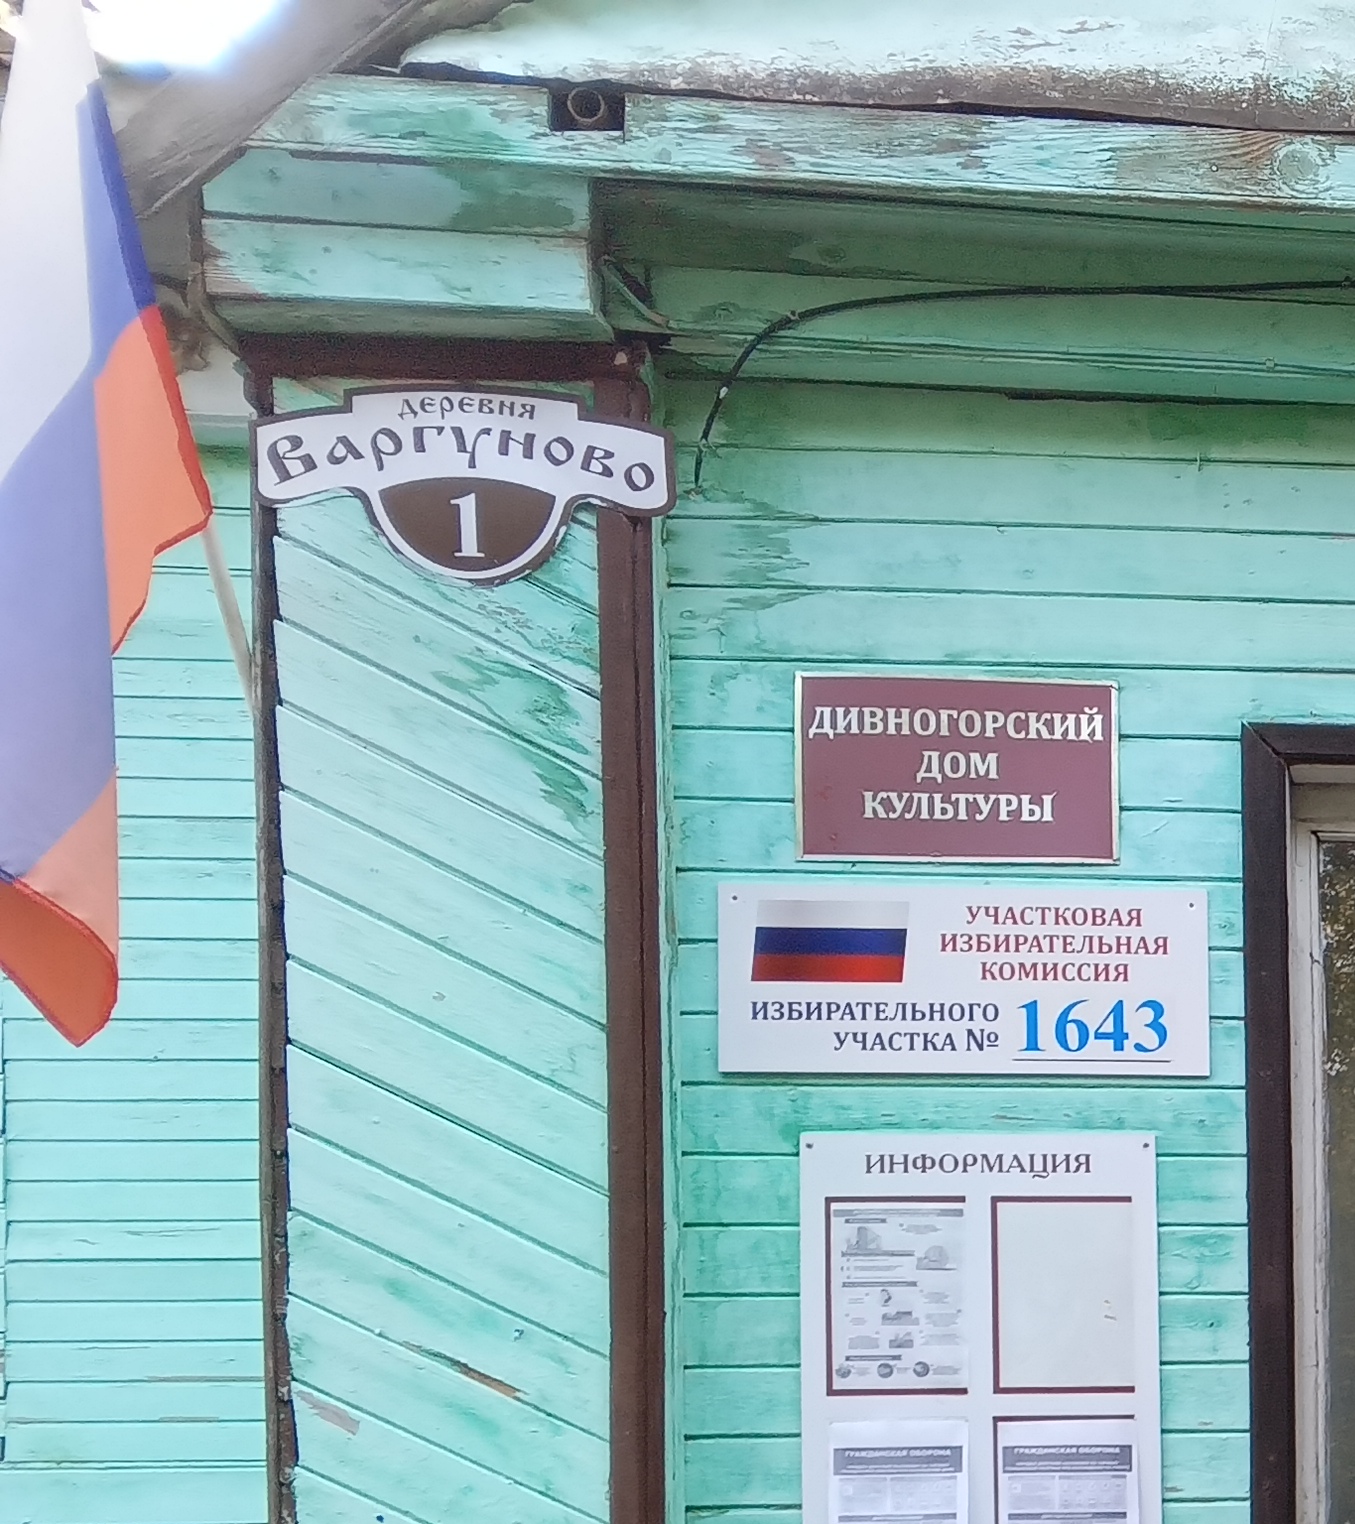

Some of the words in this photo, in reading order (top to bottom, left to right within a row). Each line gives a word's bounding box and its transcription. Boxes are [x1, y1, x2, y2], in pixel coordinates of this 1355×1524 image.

[398, 395, 536, 421] деревня
[266, 426, 655, 492] Варгуново
[449, 493, 485, 558] 1
[808, 705, 1104, 743] ДИВНОГОРСКИЙ
[916, 751, 1000, 782] ДОМ
[862, 790, 1057, 824] КУЛЬТУРЫ
[965, 905, 1143, 928] УЧАСТКОВАЯ
[940, 933, 1169, 956] ИЗБИРАТЕЛЬНАЯ
[980, 961, 1130, 983] КОМИССИЯ
[751, 1001, 1000, 1023] ИЗБИРАТЕЛЬНОГО
[833, 1030, 957, 1053] УЧАСТКА
[965, 1027, 999, 1052] №
[1017, 998, 1169, 1054] 1643
[865, 1152, 1092, 1178] ИНФОРМАЦИЯ
